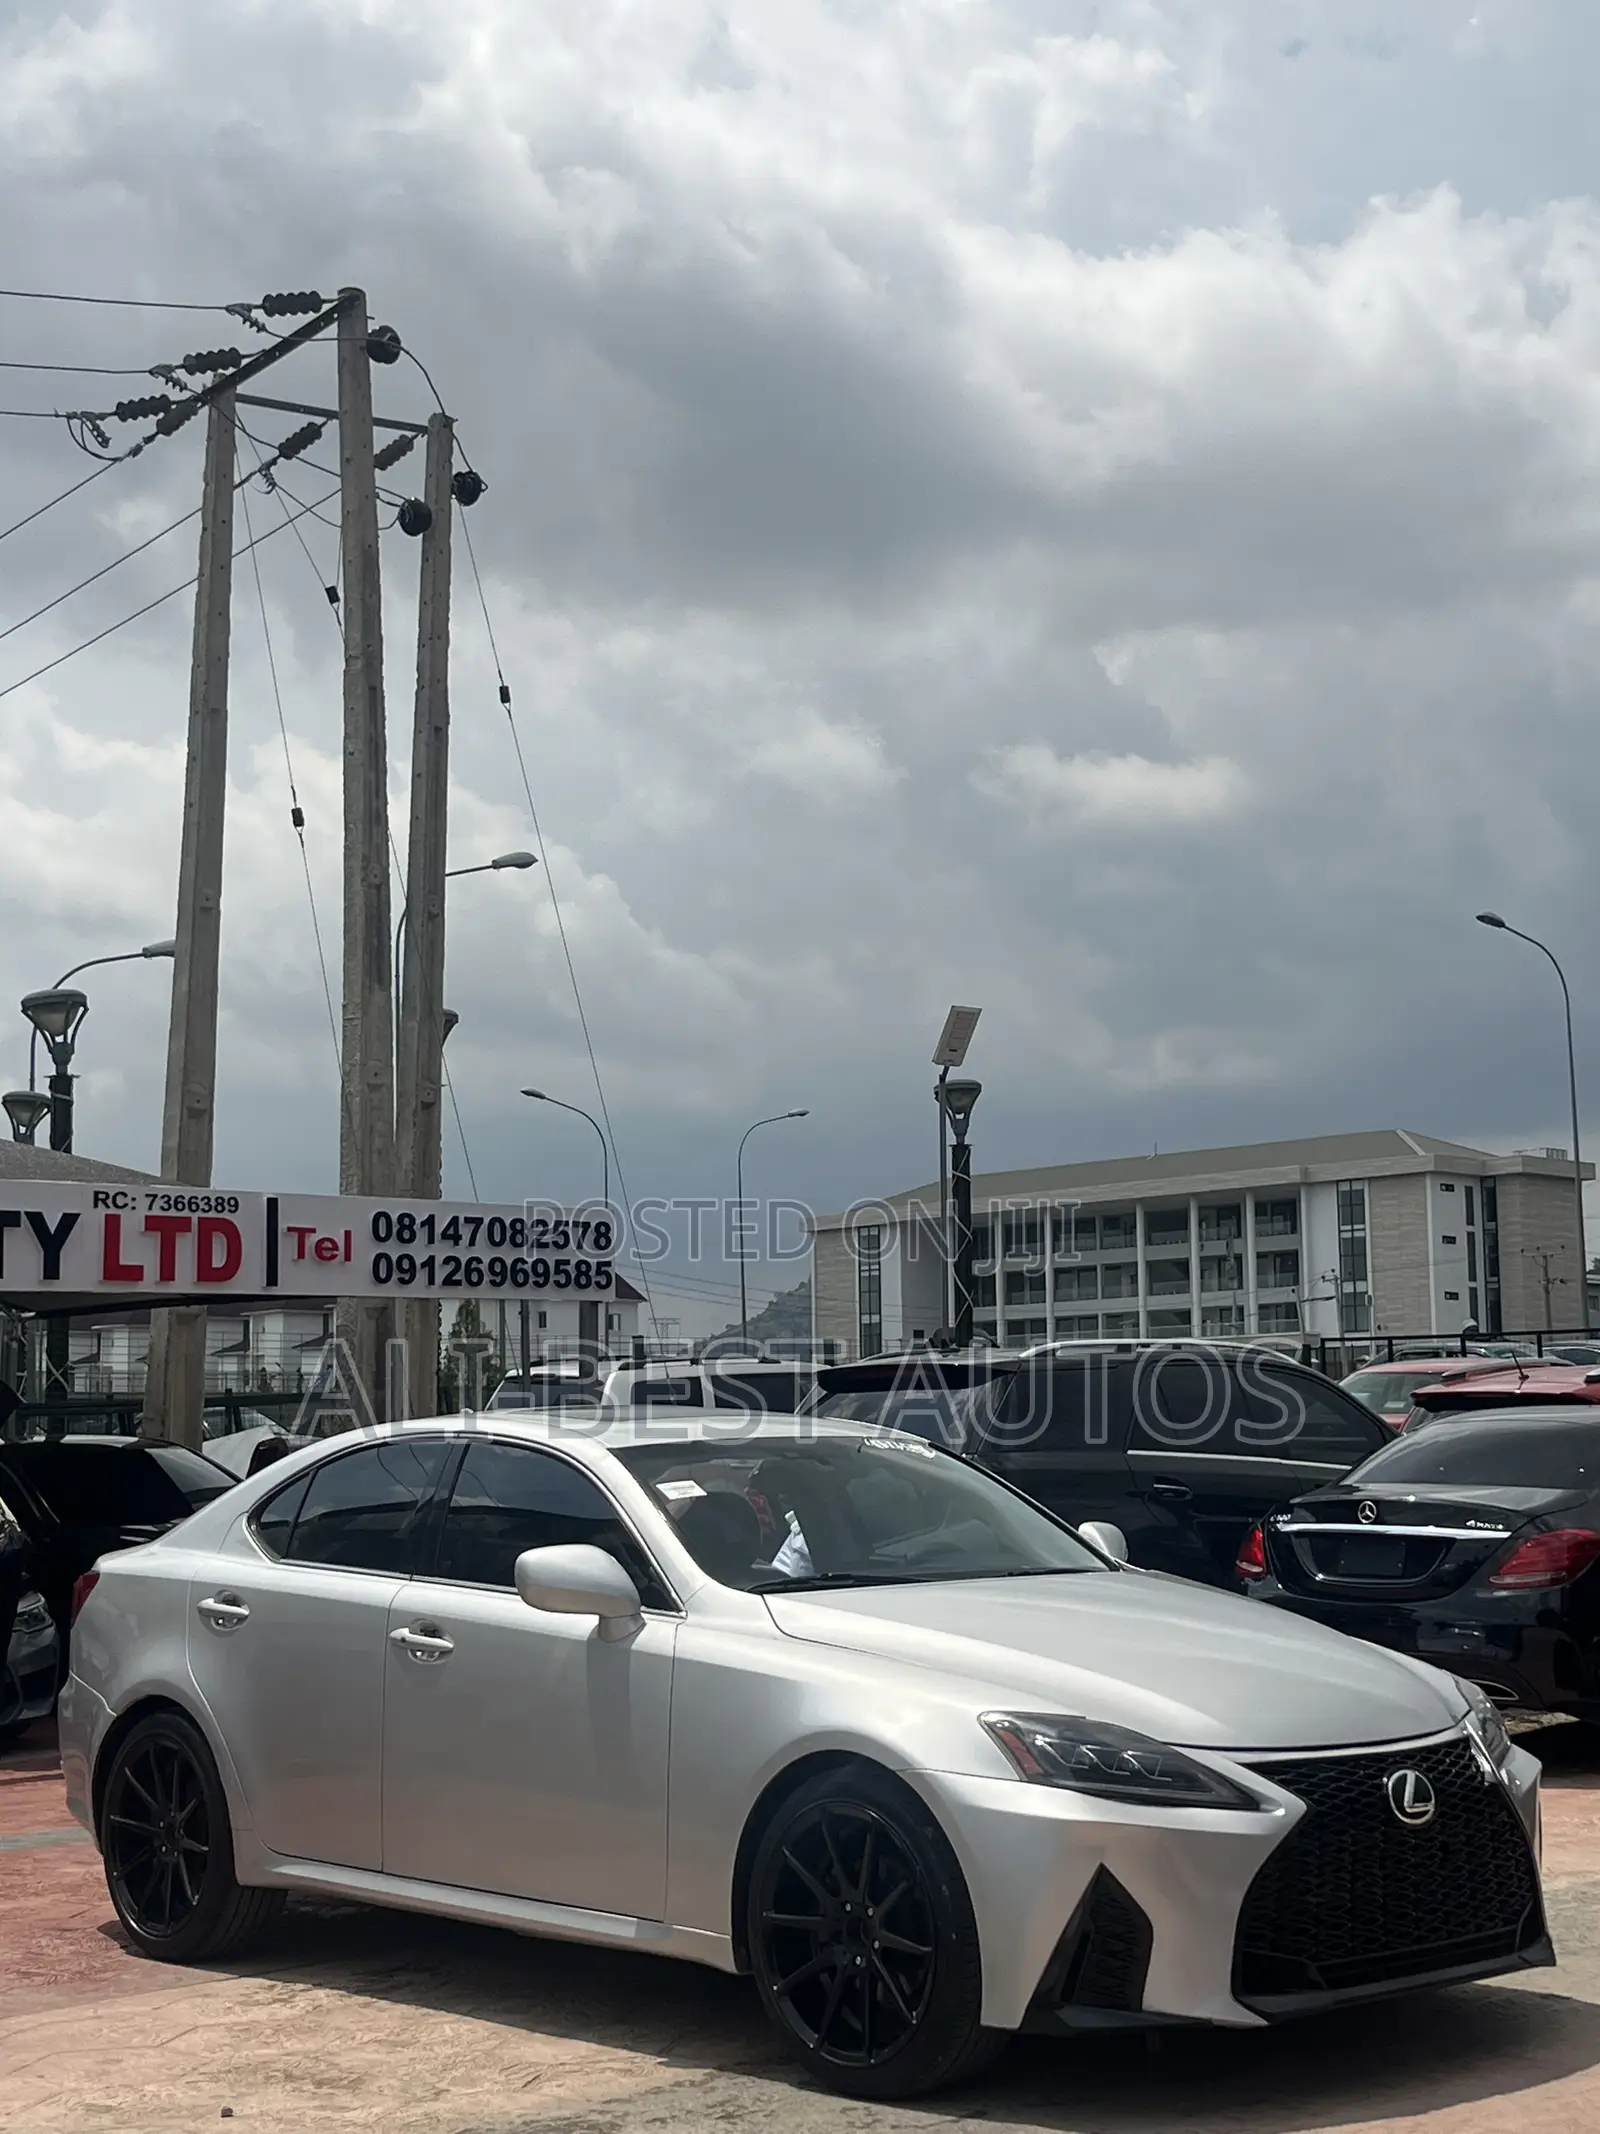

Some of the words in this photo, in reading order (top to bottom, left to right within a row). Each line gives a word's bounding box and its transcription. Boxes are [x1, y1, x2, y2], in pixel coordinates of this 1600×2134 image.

[92, 1190, 137, 1211] RC:
[145, 1193, 240, 1214] 7366389
[102, 1213, 243, 1282] LTD
[286, 1226, 352, 1263] Tel
[371, 1210, 612, 1251] 08147082578
[372, 1252, 613, 1290] 09126969585
